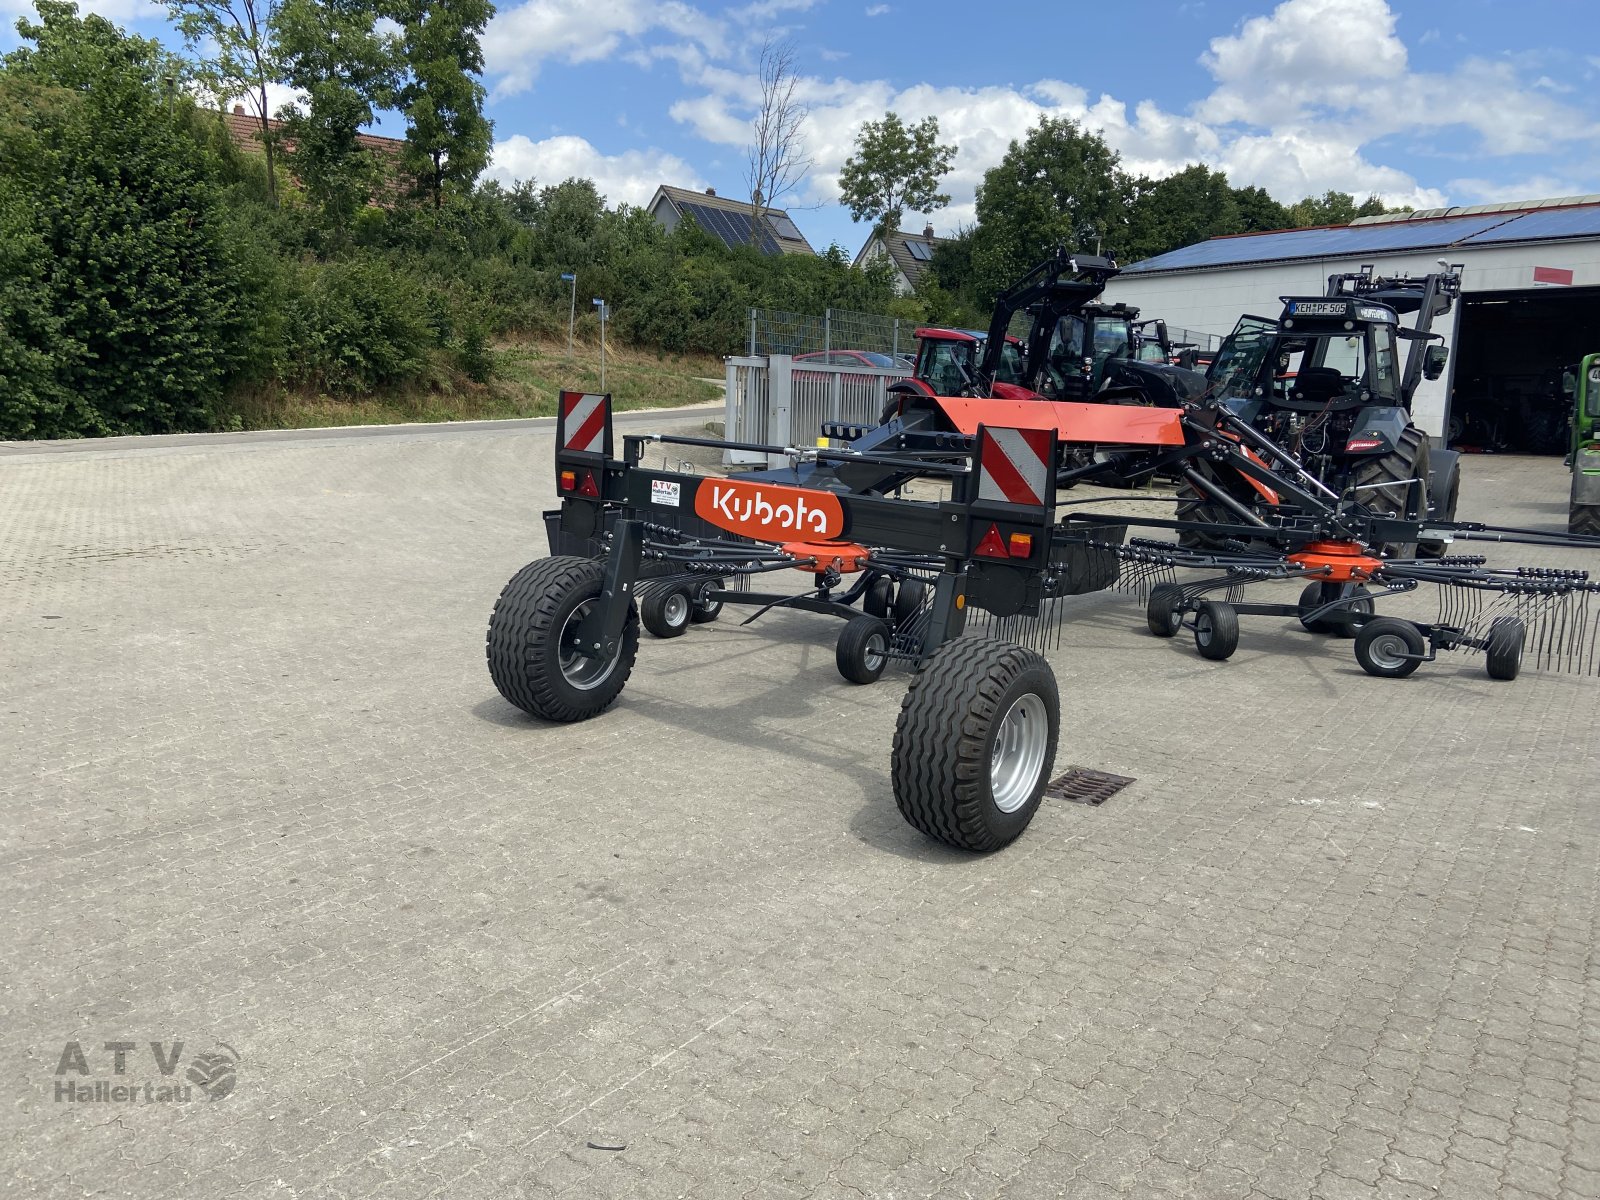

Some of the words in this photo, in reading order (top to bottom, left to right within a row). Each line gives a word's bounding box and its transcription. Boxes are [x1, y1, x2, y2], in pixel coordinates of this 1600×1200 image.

[1295, 303, 1312, 313] KEH
[1317, 303, 1328, 313] PF
[1329, 303, 1346, 313] 505
[713, 486, 827, 533] Kubota
